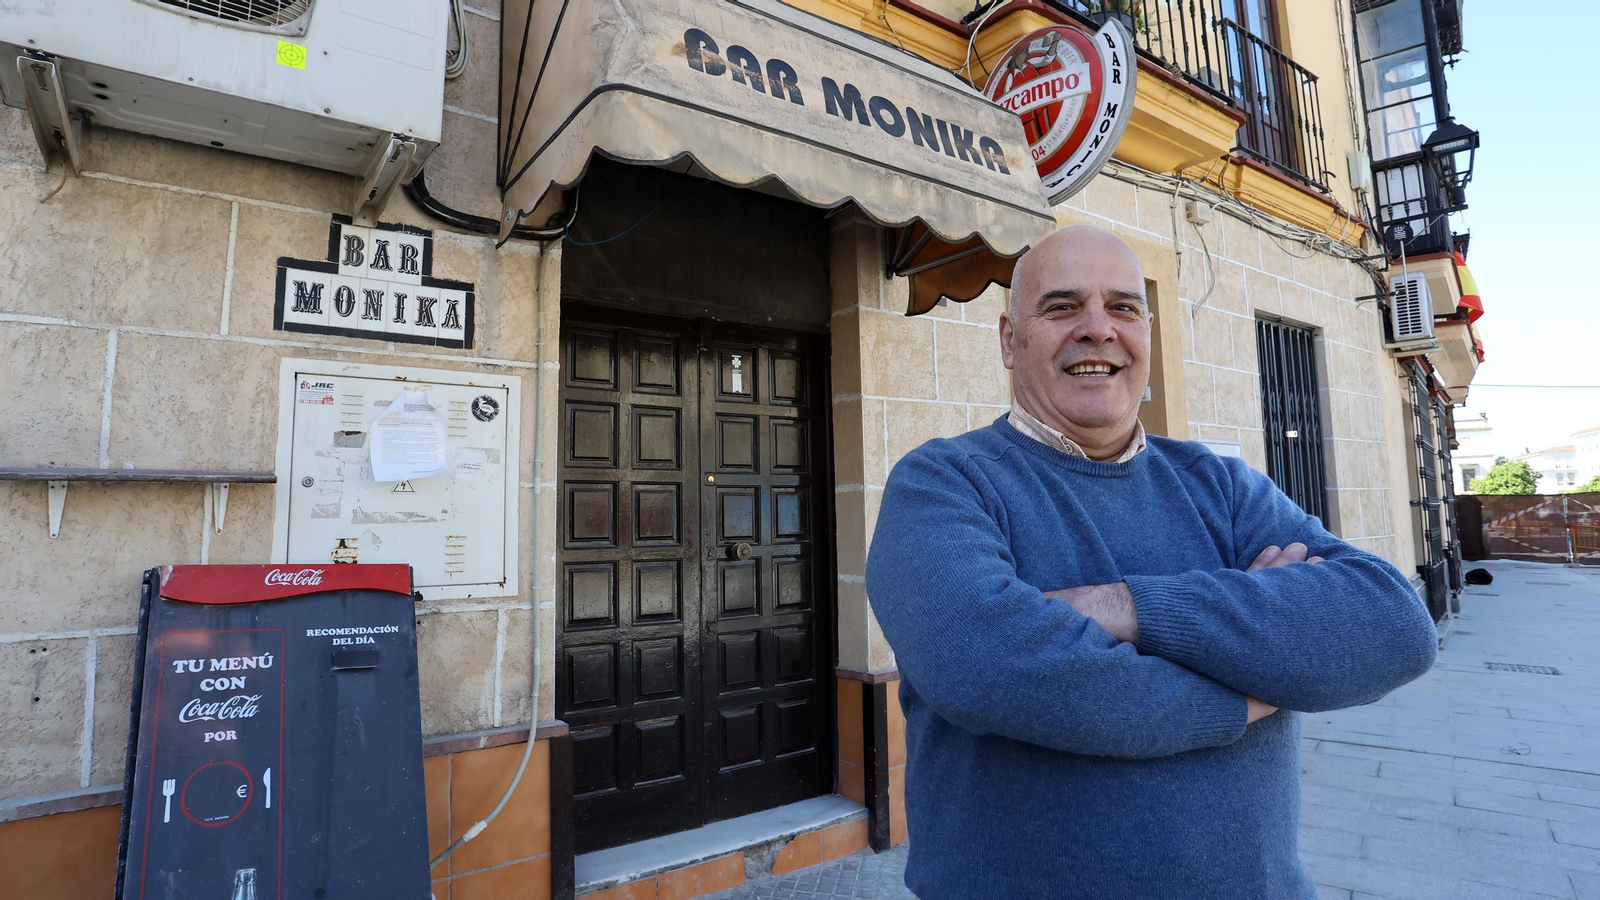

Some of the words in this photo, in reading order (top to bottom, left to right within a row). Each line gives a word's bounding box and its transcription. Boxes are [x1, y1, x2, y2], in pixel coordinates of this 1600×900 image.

[1061, 48, 1078, 65] BEER
[1103, 32, 1122, 85] BAR
[684, 27, 805, 105] BAR
[822, 76, 1011, 176] MONIKA
[1000, 73, 1079, 110] zcampo
[342, 232, 420, 275] BAR
[291, 279, 463, 331] MONIKA
[264, 568, 325, 587] Coca-Cola
[306, 624, 399, 637] RECOMENDACIÓN
[332, 637, 354, 646] DEL
[355, 635, 375, 645] DÍA
[172, 659, 204, 674] TU
[209, 652, 274, 671] MENÚ
[200, 676, 246, 692] CON
[178, 694, 263, 723] Coca-Cola
[203, 729, 238, 743] POR
[236, 784, 248, 798] €
